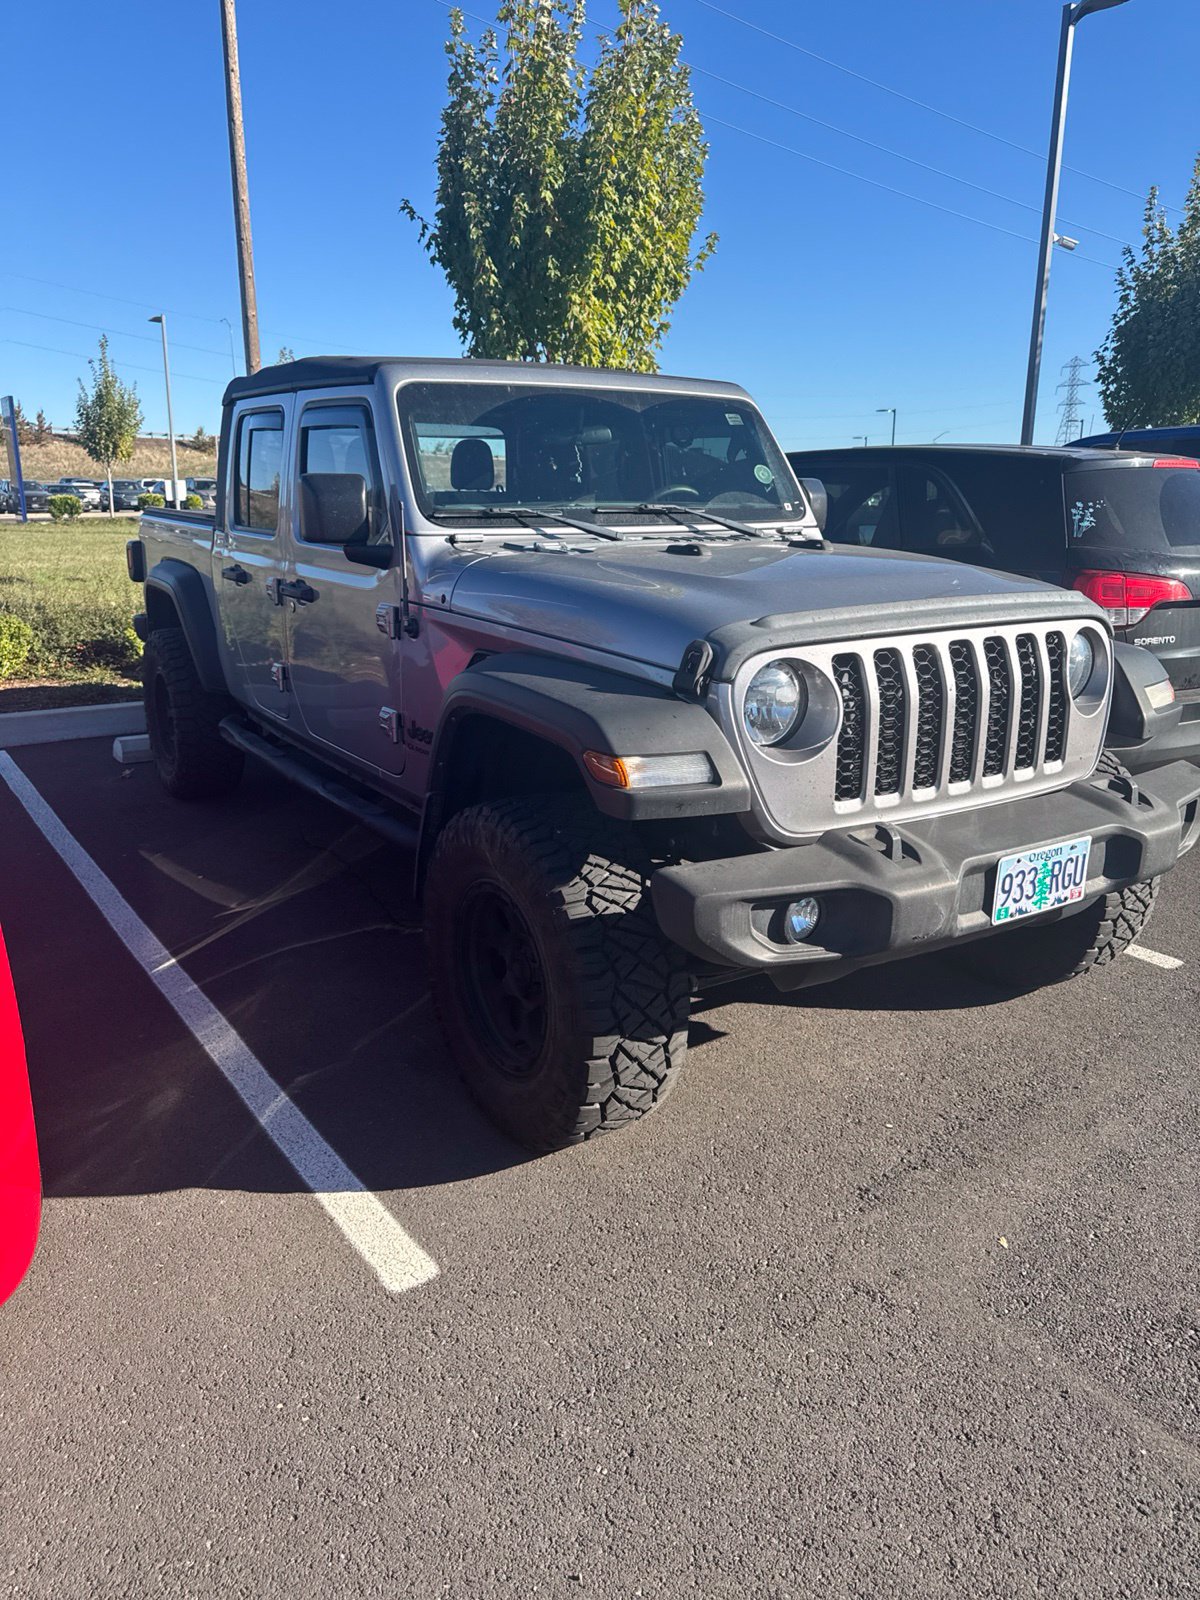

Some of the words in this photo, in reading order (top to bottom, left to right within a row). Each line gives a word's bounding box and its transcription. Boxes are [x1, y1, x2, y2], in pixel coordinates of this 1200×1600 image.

[1134, 635, 1176, 646] SORENTO
[407, 720, 434, 745] Jeep
[1029, 847, 1063, 863] Oregon
[1001, 866, 1038, 907] 933
[1049, 853, 1087, 895] RGU
